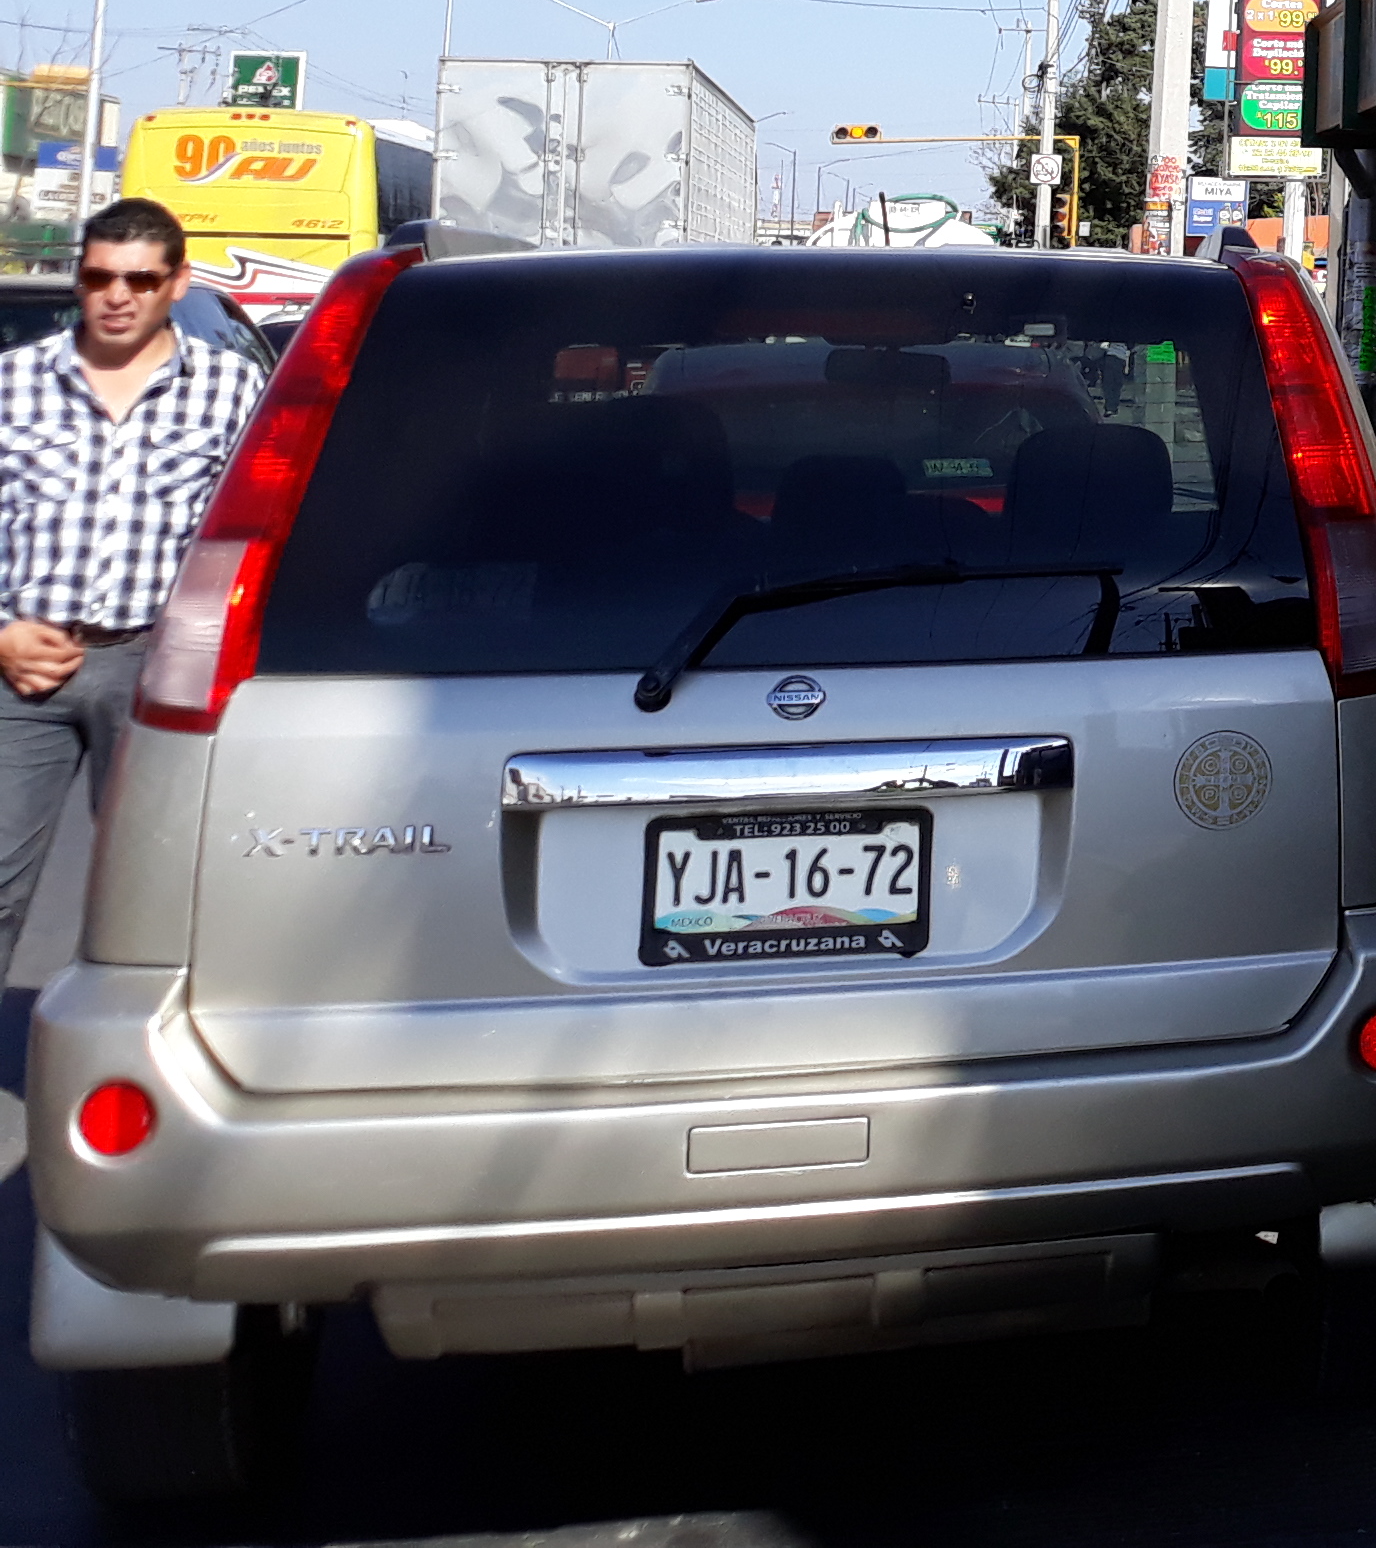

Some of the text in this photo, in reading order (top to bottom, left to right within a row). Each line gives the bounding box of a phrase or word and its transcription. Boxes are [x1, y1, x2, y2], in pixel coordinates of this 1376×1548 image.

[174, 134, 236, 180] 90
[228, 155, 317, 181] AU
[1205, 187, 1232, 196] MIYA
[773, 693, 820, 702] NISSAN
[242, 824, 452, 858] X-TRAIL
[733, 821, 850, 837] TEL: 923 25 00
[667, 844, 914, 907] YJA-16-72
[671, 916, 713, 928] MEXICO
[704, 933, 866, 957] Veracruzana
